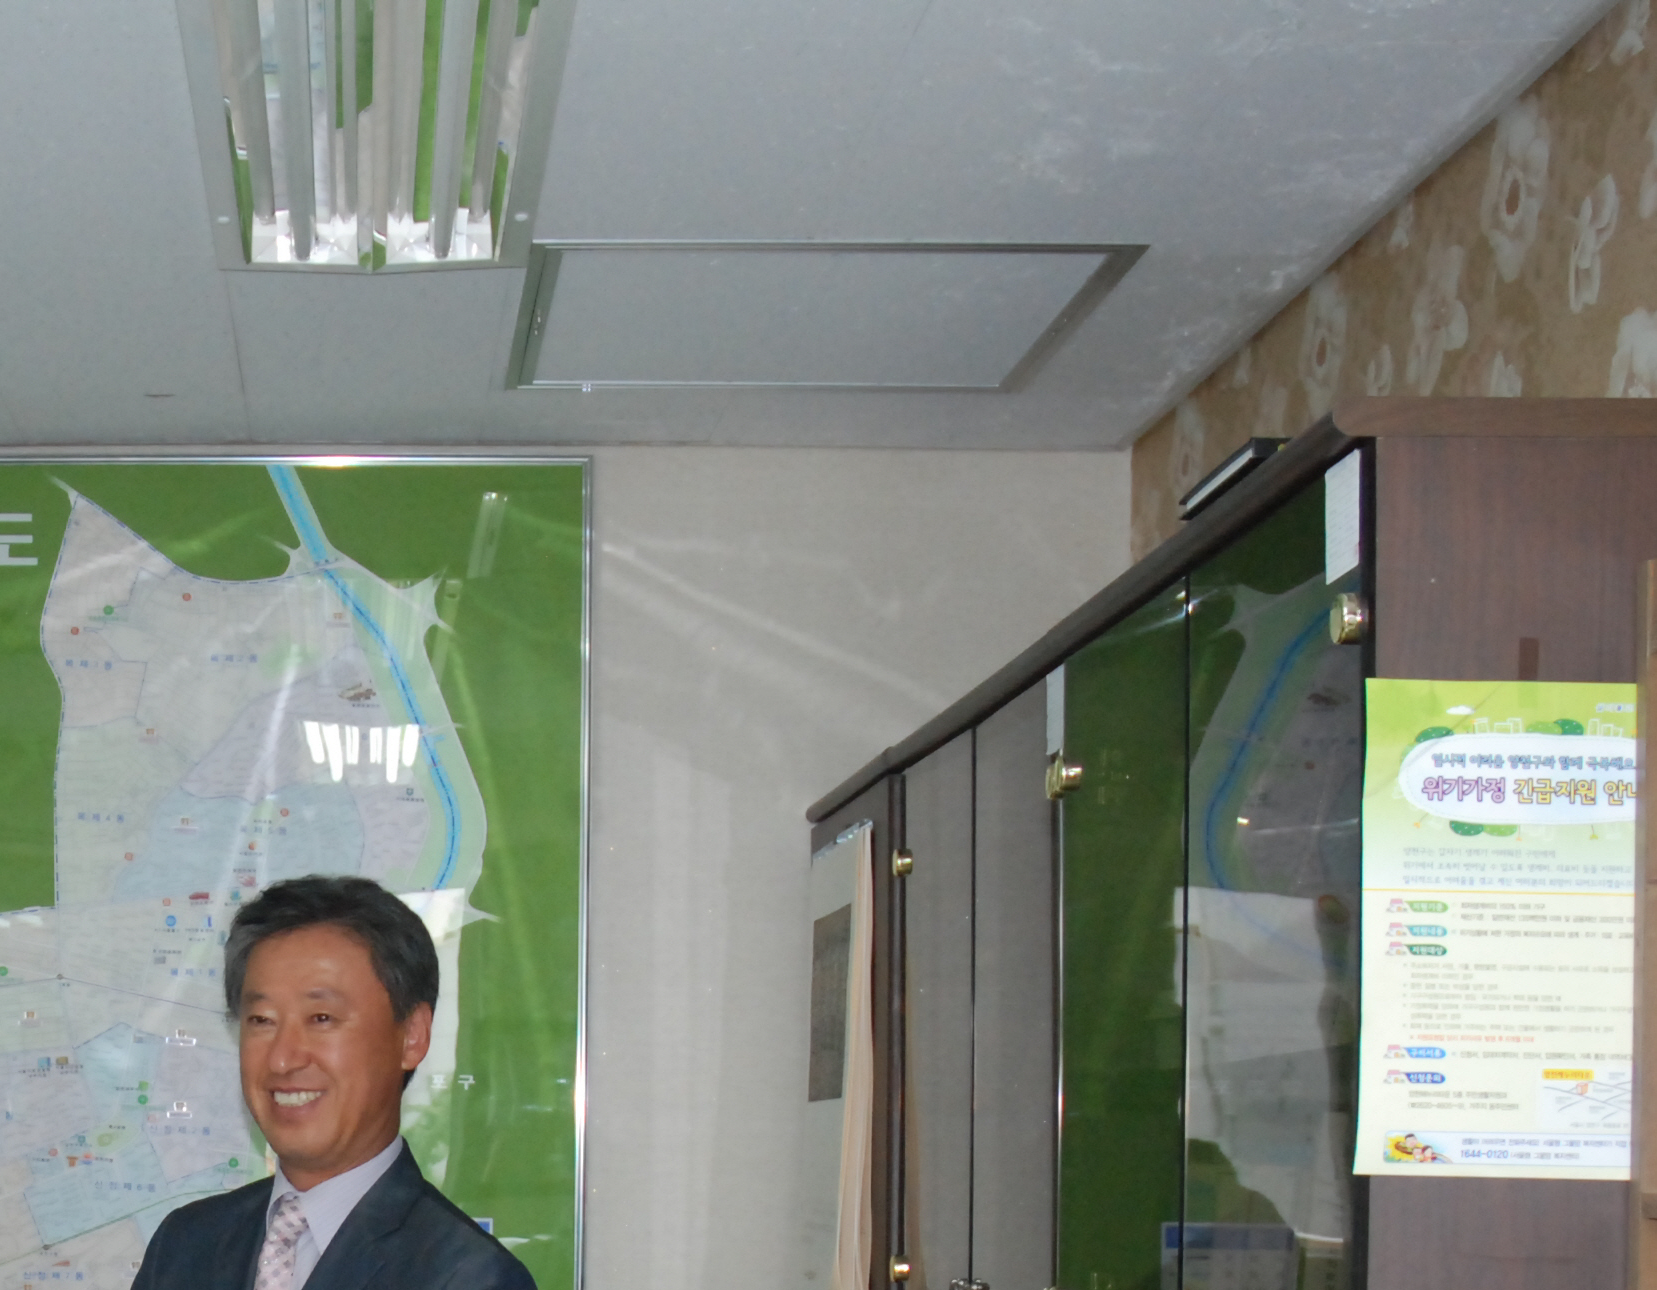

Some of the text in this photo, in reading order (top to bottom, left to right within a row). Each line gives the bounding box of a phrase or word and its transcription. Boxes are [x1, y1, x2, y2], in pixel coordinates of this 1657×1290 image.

[1421, 775, 1506, 804] 위기가정
[1513, 777, 1597, 805] 긴급지원
[1460, 1149, 1510, 1160] 1644-0120
